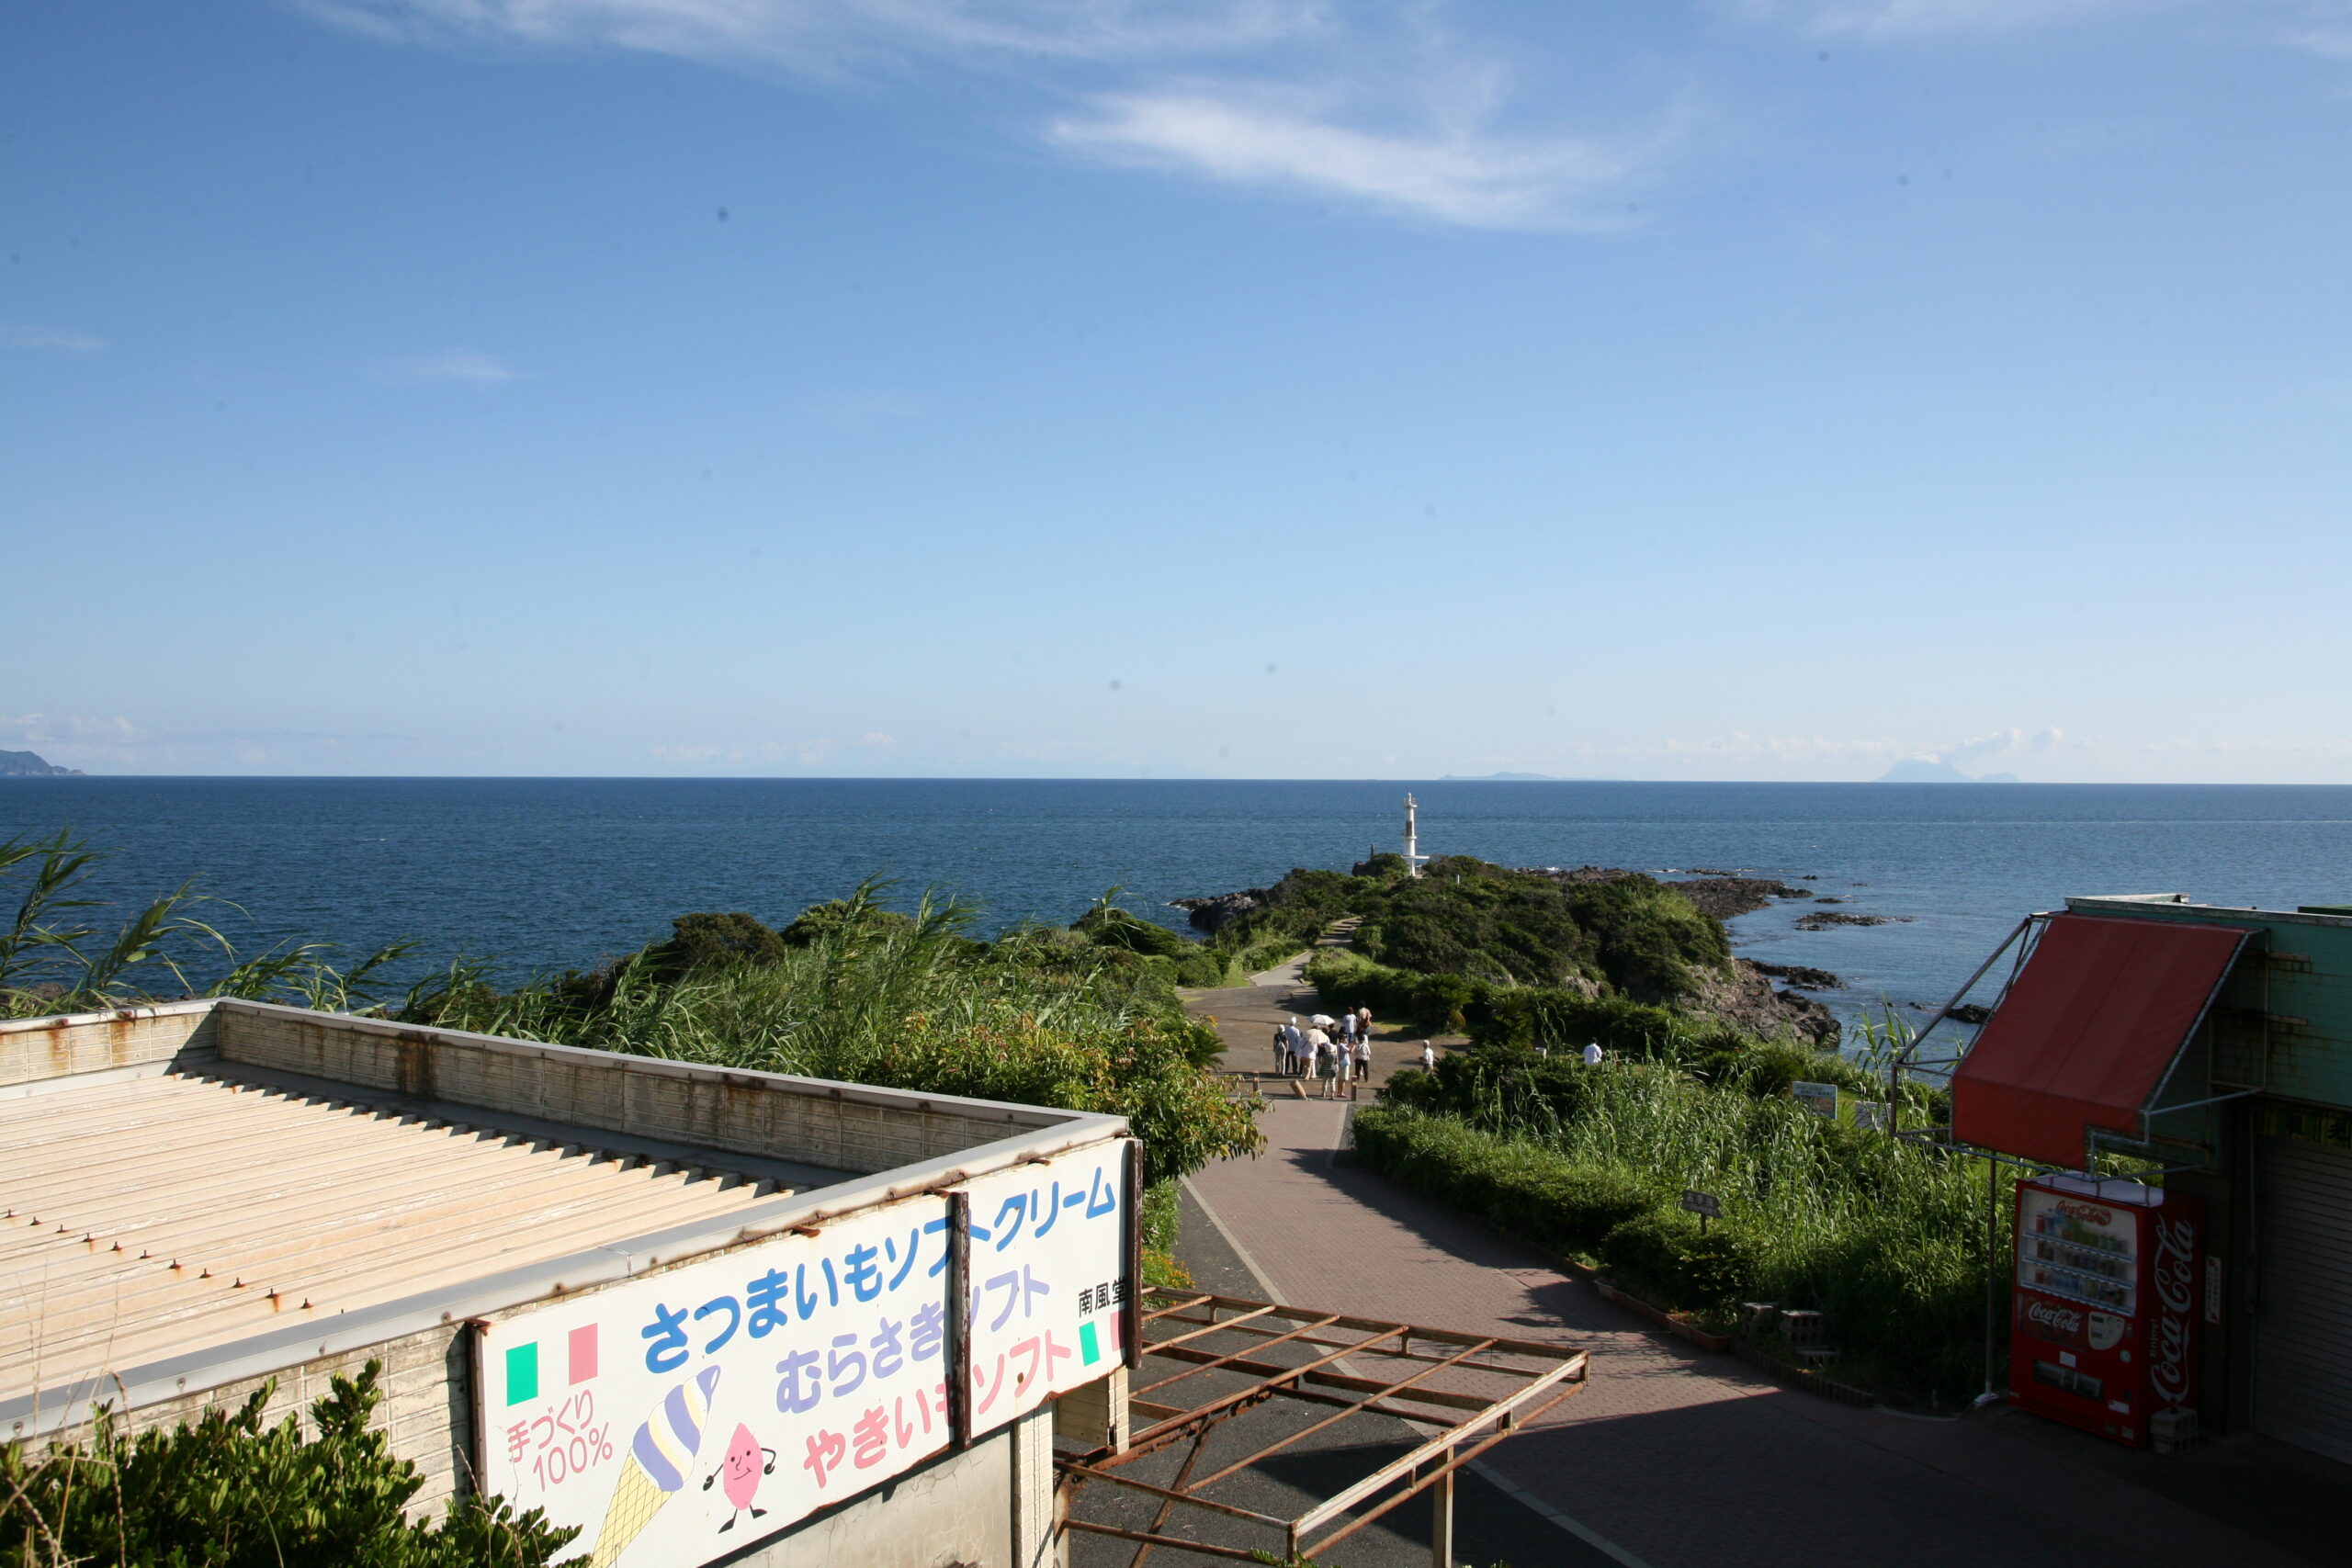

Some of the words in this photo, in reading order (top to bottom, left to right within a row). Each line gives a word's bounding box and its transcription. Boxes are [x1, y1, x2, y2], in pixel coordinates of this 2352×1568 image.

[1079, 1276, 1128, 1318] 南風堂
[506, 1389, 594, 1462] 手づくり
[532, 1421, 614, 1493] 100%
